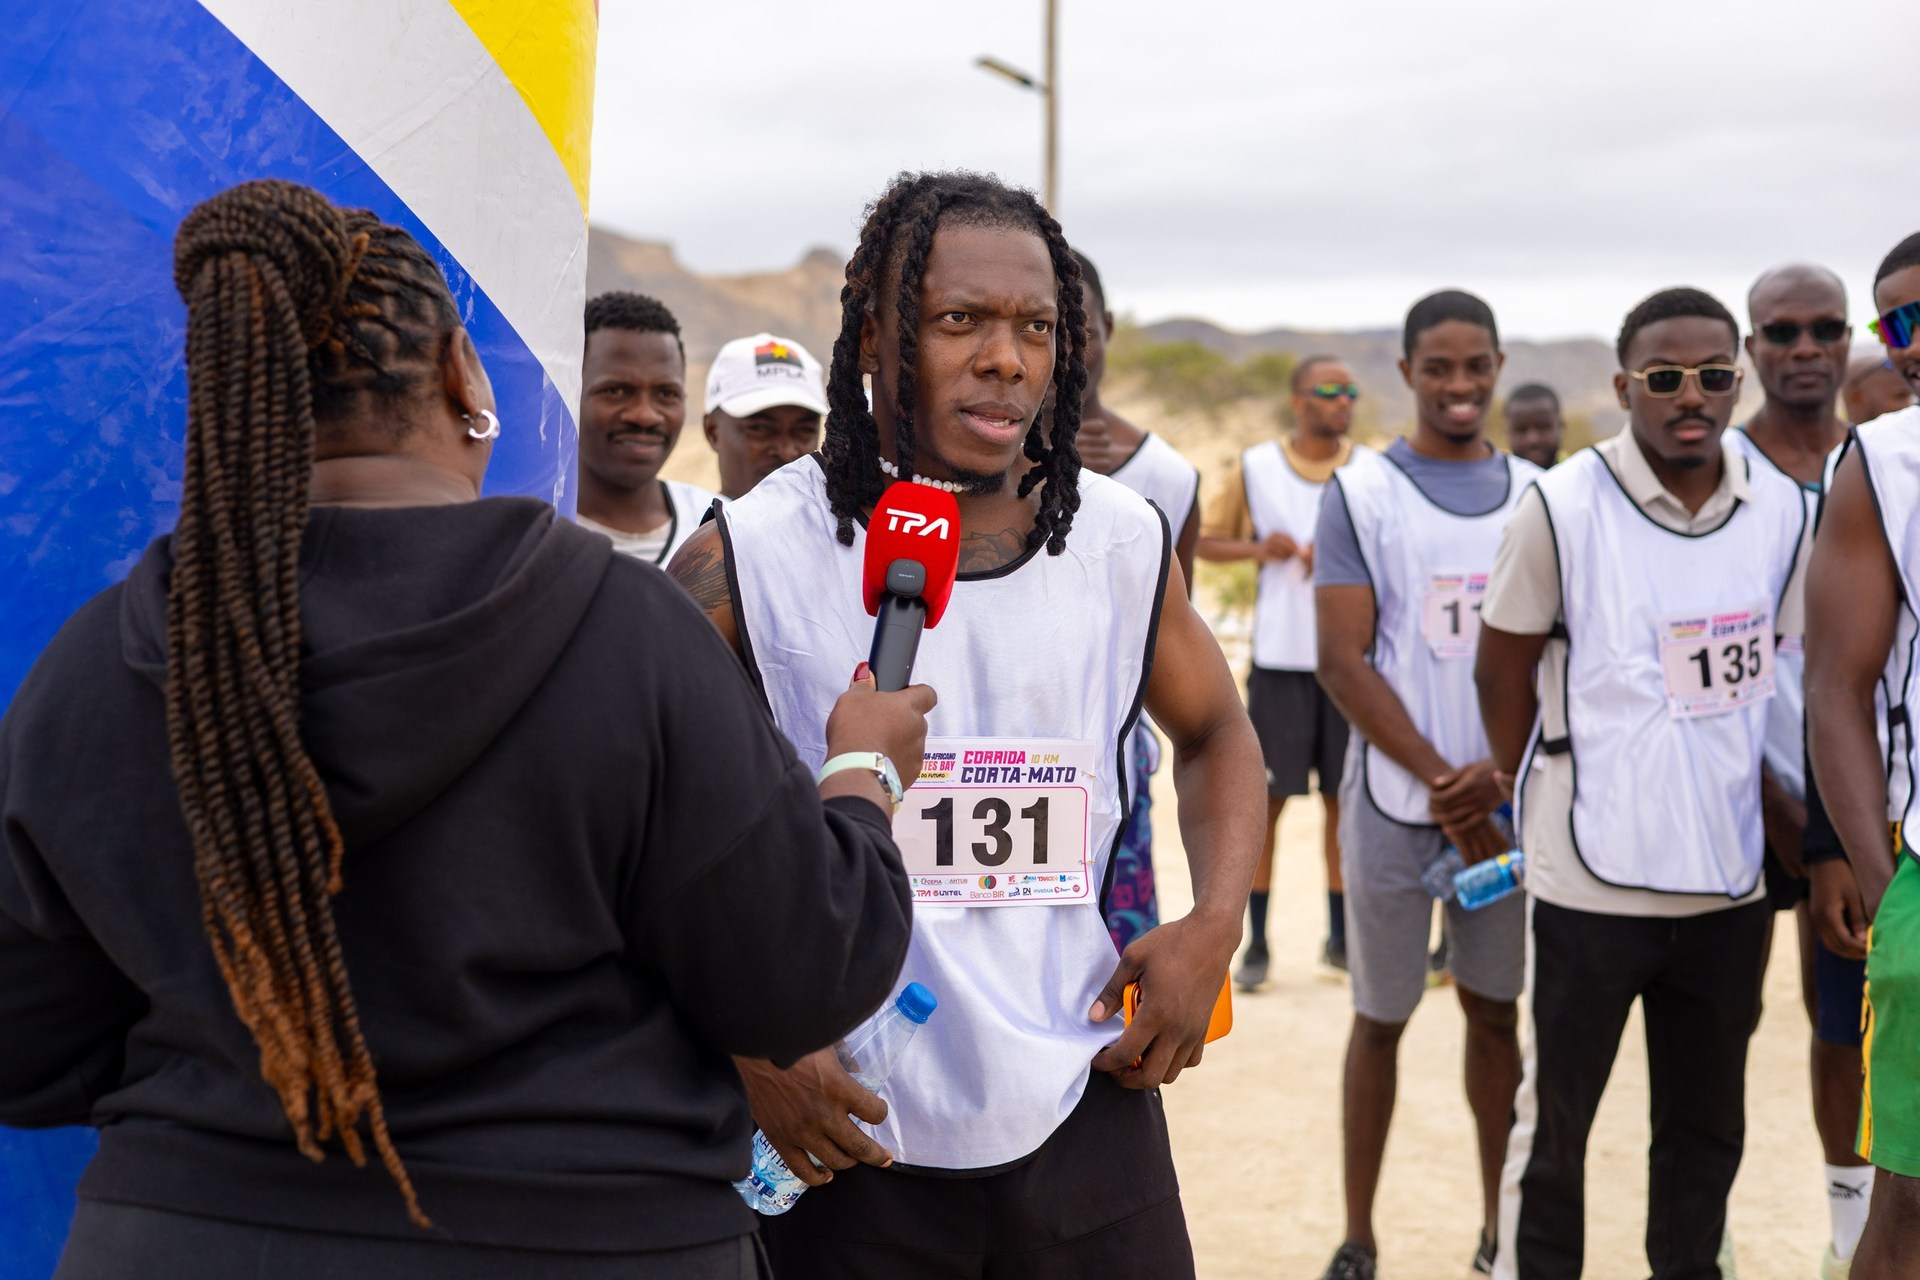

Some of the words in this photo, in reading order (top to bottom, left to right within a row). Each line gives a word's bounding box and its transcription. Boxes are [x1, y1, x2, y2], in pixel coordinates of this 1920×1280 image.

[886, 508, 949, 540] TPA
[1689, 636, 1761, 688] 135
[924, 752, 956, 760] AN-AFRICANO
[963, 750, 1026, 764] CORRIDA
[1030, 754, 1040, 764] 10
[1043, 754, 1060, 764] KM
[924, 761, 938, 771] TES
[939, 761, 956, 771] BAY
[960, 766, 1077, 783] CORTA-MATO
[921, 797, 1049, 867] 131
[916, 889, 931, 897] TPA
[970, 891, 991, 899] Banco
[992, 890, 1005, 899] BIR
